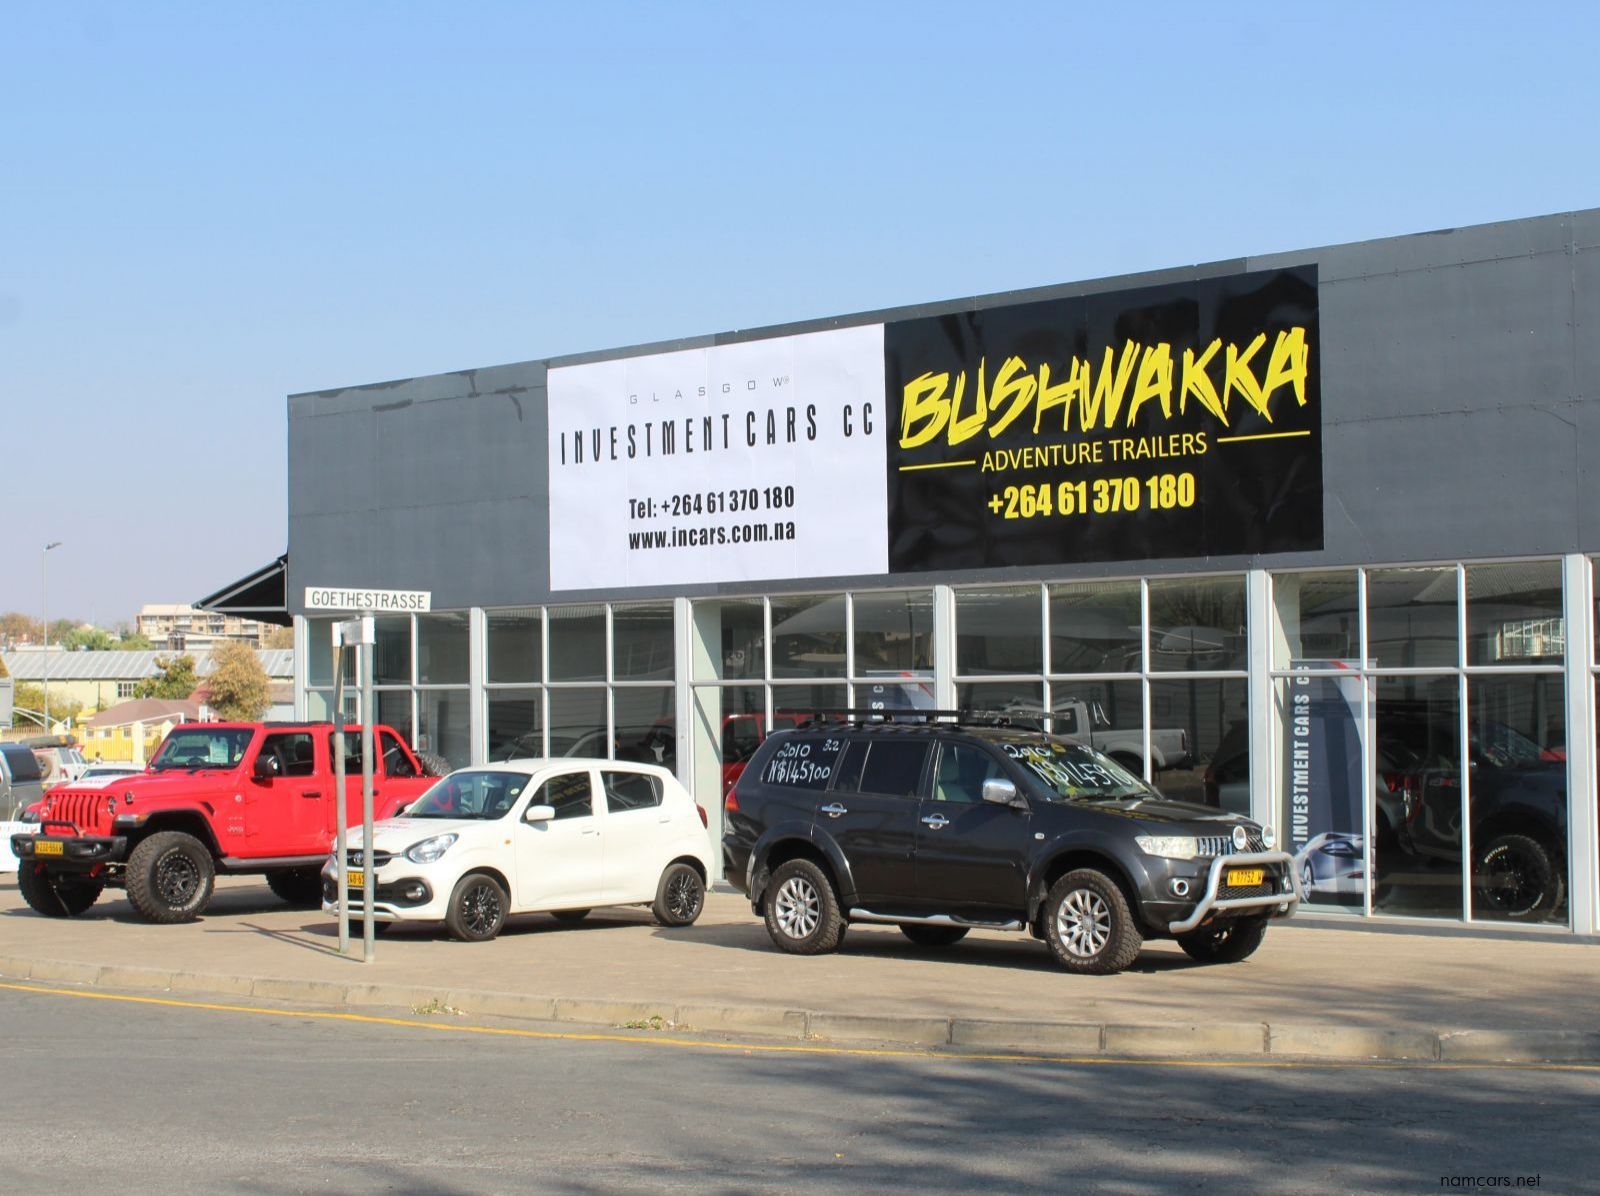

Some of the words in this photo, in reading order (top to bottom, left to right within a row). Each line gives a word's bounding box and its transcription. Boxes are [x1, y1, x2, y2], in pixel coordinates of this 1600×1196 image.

[898, 326, 1309, 449] BUSHWAKKA
[560, 413, 730, 465] INVESTMENT
[745, 403, 817, 447] CARS
[843, 402, 873, 437] CC
[981, 440, 1103, 473] ADVENTURE
[1108, 431, 1208, 461] TRAILERS
[629, 497, 657, 519] Tel:
[661, 493, 703, 517] +264
[706, 491, 725, 514] 61
[728, 488, 759, 512] 370
[763, 485, 795, 509] 180
[987, 484, 1053, 520] +264
[1058, 481, 1087, 516] 61
[1093, 476, 1140, 513] 370
[1145, 472, 1196, 511] 180
[628, 520, 796, 551] www.incars.com.na
[311, 590, 425, 610] GOETHESTRASSE
[1294, 694, 1310, 737] CARS
[777, 742, 811, 758] 2010
[1293, 741, 1309, 842] INVESTMENT
